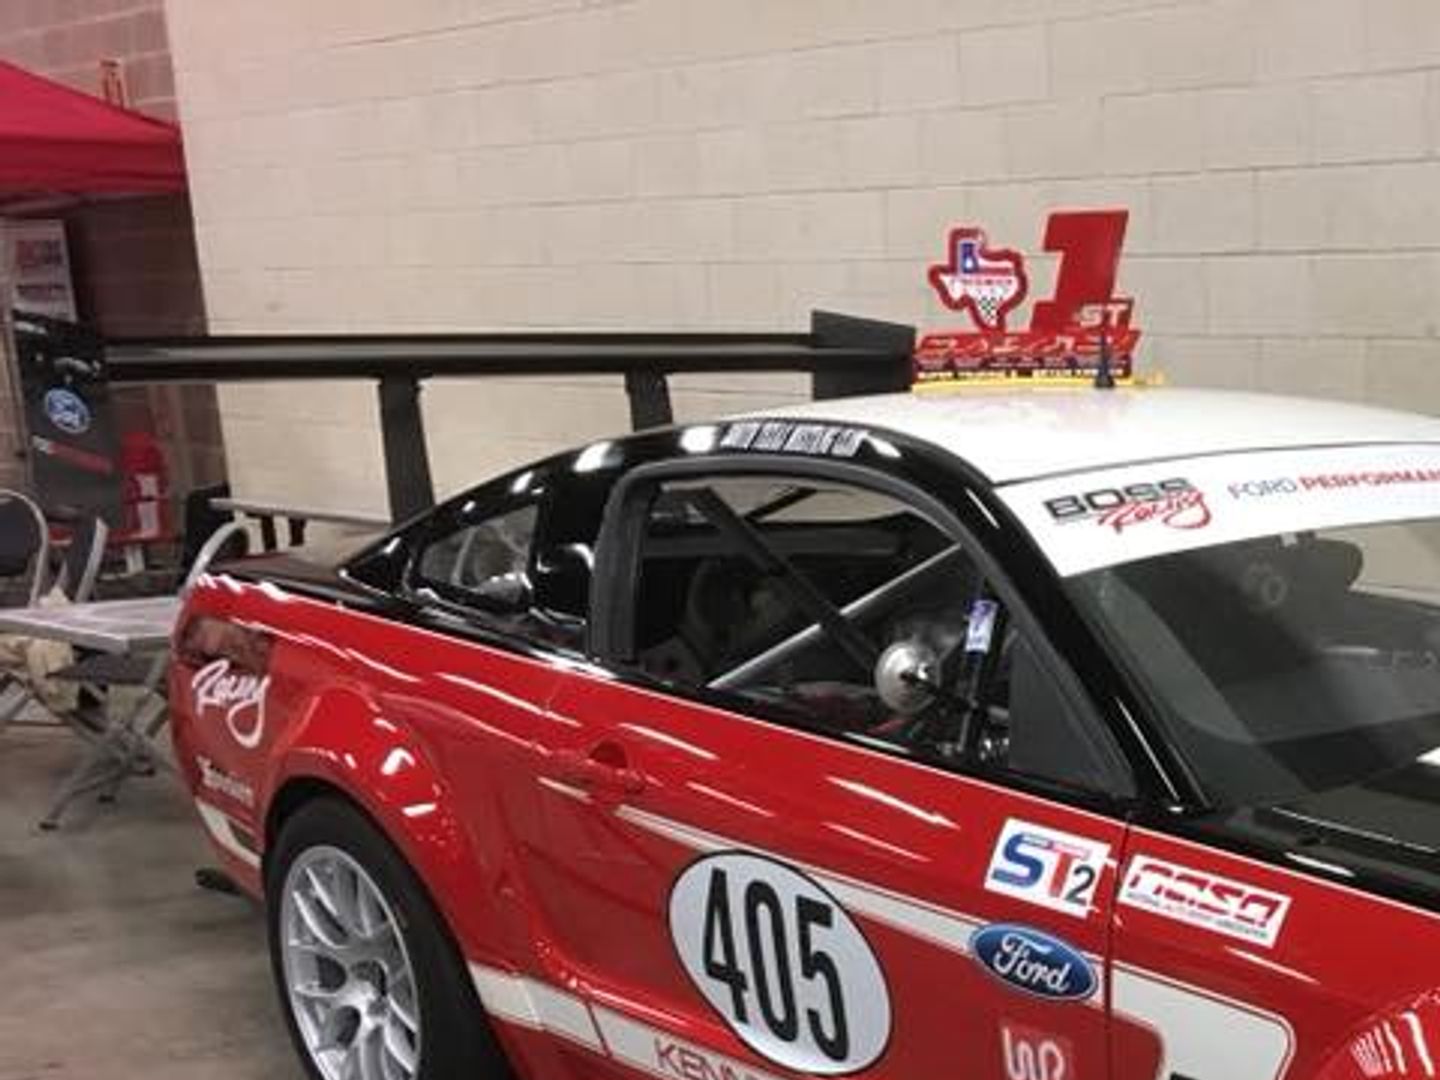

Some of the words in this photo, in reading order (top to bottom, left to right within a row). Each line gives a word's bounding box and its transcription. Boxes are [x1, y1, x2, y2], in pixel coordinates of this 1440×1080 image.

[1043, 477, 1190, 521] BOSS
[1097, 488, 1212, 534] Racing
[1227, 477, 1298, 499] FORD
[192, 659, 271, 748] Racing
[702, 867, 849, 1062] 405
[992, 932, 1072, 994] Ford
